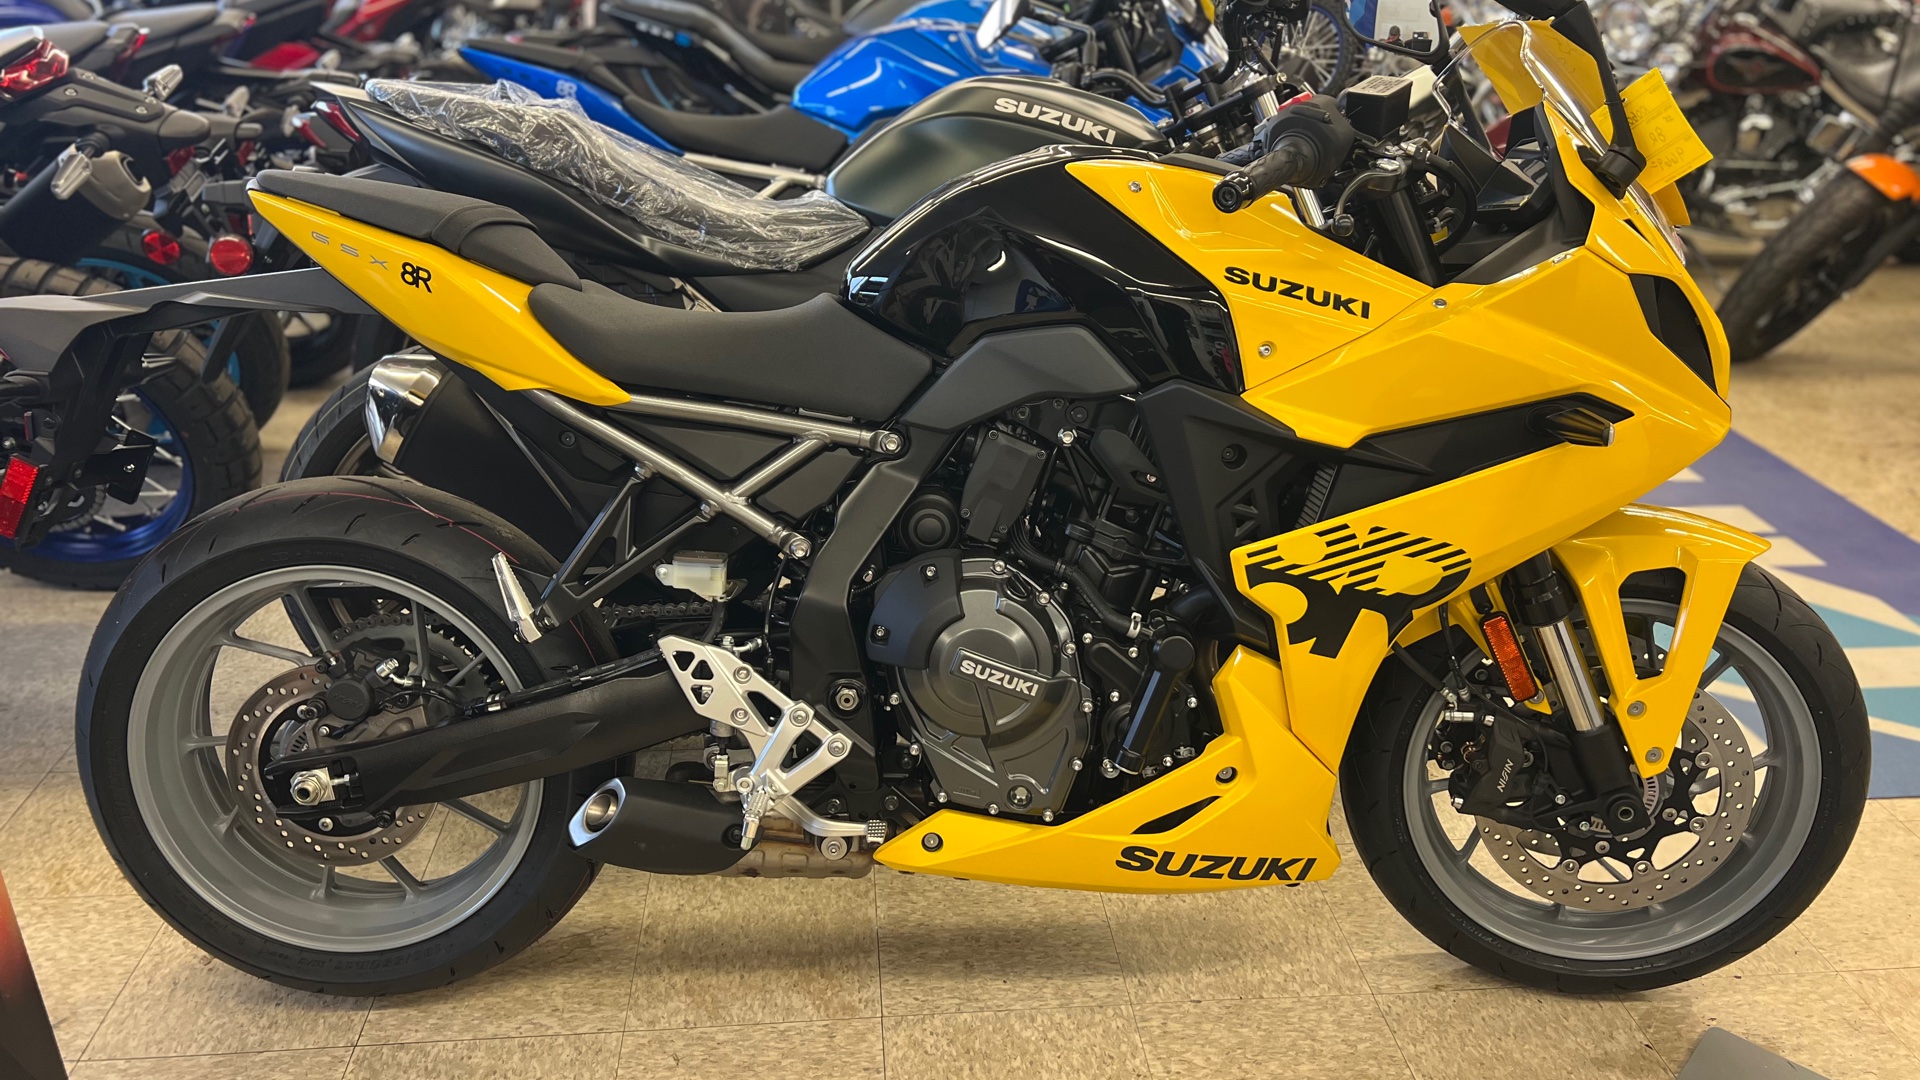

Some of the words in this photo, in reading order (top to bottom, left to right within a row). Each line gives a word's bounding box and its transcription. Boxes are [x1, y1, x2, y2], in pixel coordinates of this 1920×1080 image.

[994, 97, 1116, 145] SUZUKI
[400, 261, 433, 294] 8R
[1223, 266, 1371, 320] SUZUKI
[959, 659, 1040, 697] SUZUKI
[1115, 845, 1318, 881] SUZUKI
